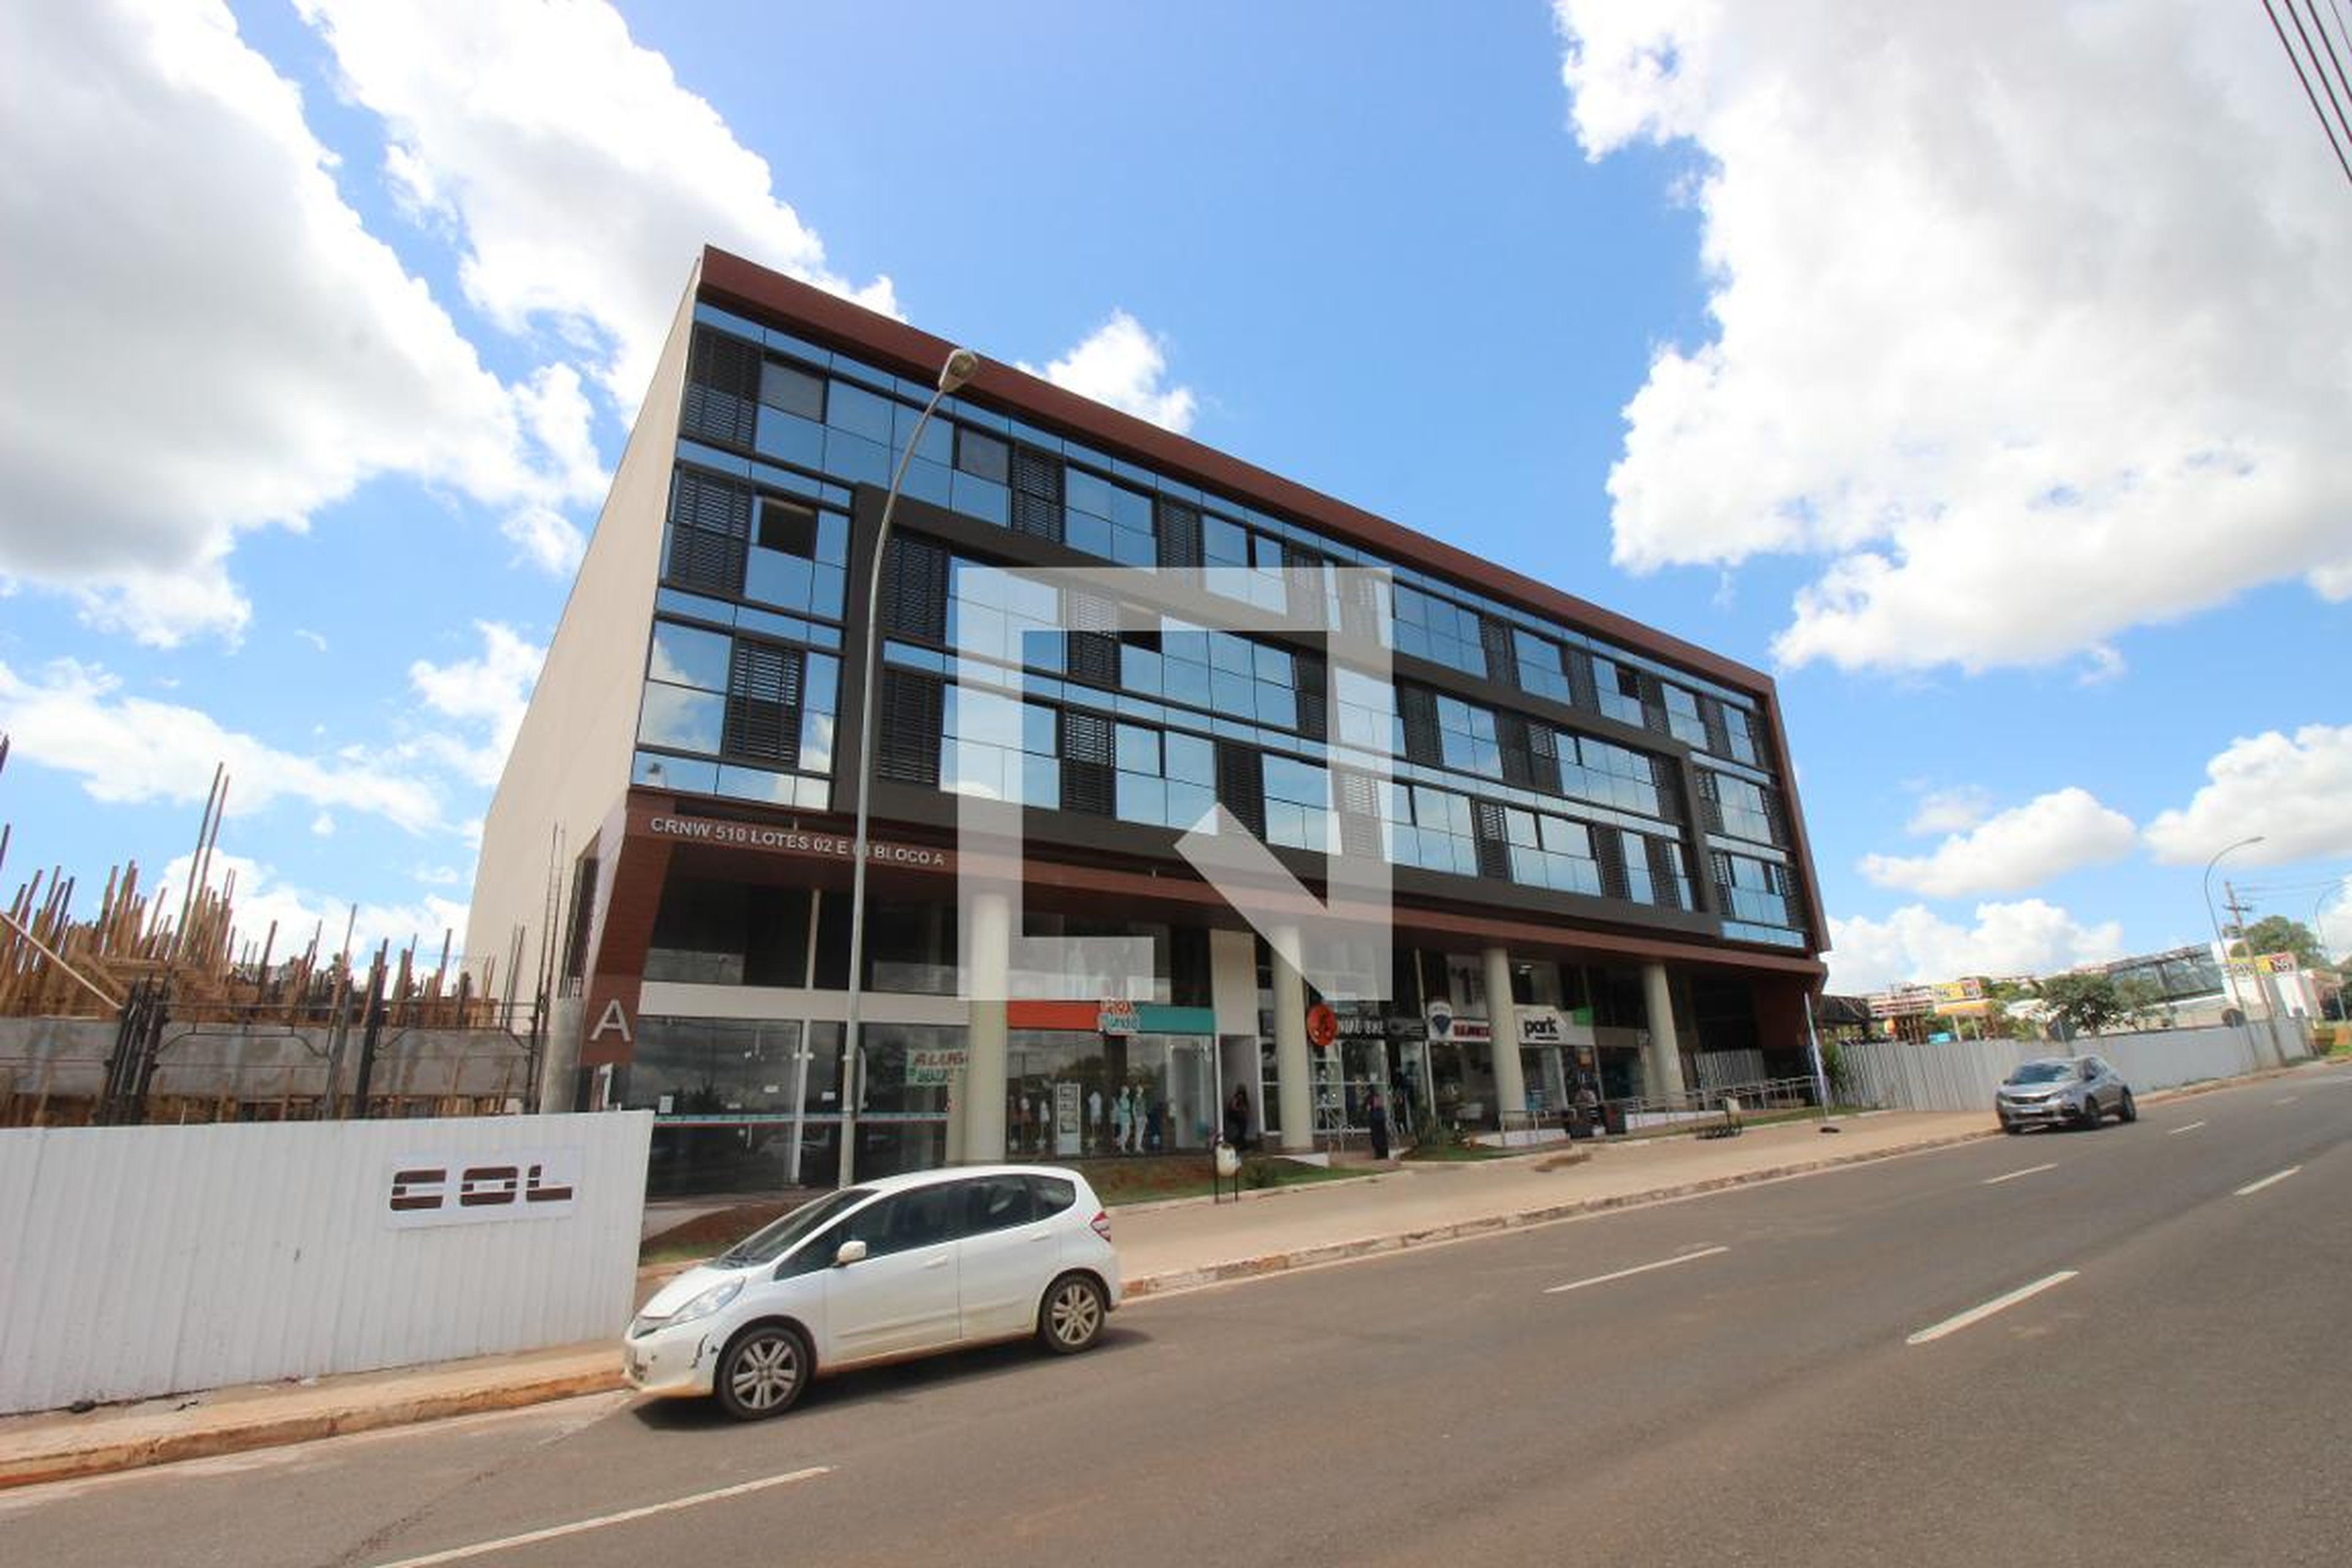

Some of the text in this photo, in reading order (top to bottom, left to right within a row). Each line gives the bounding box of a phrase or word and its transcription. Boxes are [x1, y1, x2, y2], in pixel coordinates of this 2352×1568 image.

[650, 818, 711, 837] CRNW
[715, 826, 747, 842] 510
[750, 829, 809, 850] LOTES
[813, 837, 832, 852] 02
[836, 840, 848, 854] E
[875, 845, 930, 864] BLOCO
[933, 853, 945, 867] A
[589, 999, 632, 1042] A
[1524, 1016, 1558, 1038] park
[390, 1164, 572, 1211] COL
